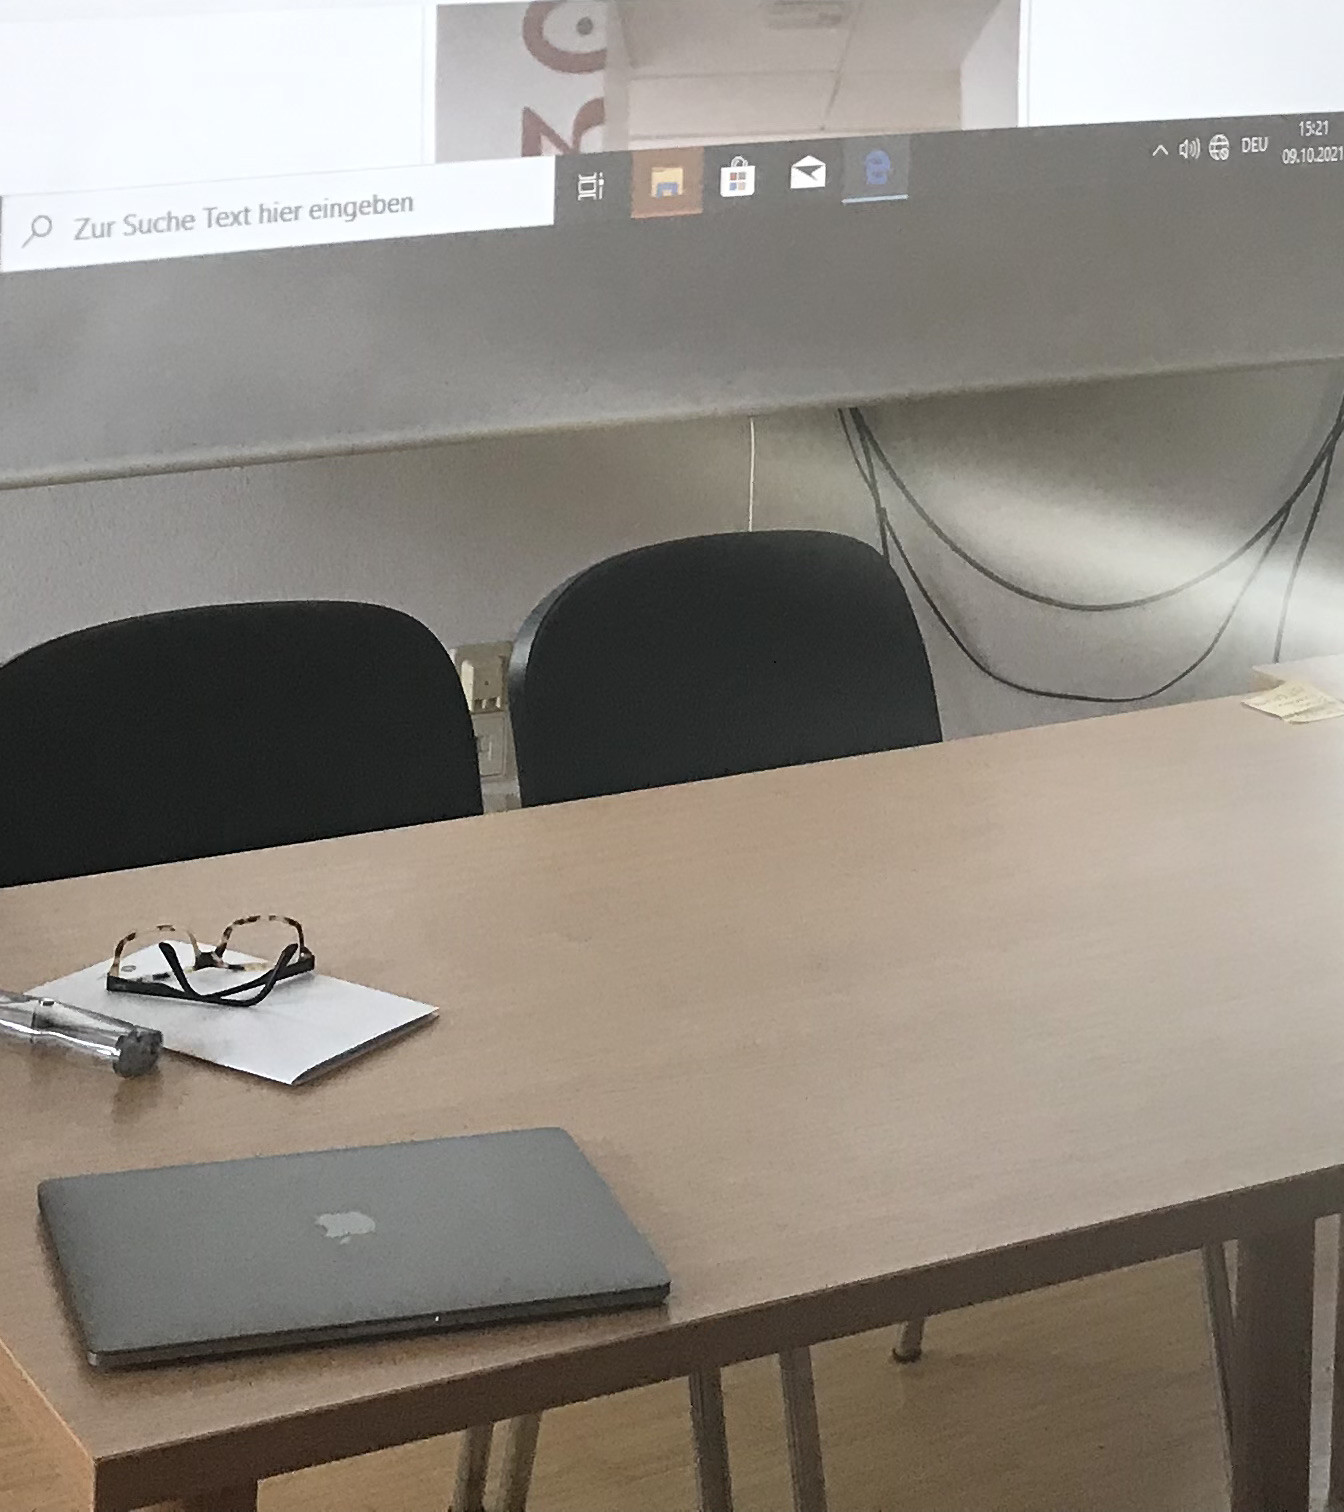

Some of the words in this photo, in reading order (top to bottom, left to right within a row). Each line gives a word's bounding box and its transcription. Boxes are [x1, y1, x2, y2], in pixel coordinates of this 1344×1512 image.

[1298, 120, 1329, 137] 15:21
[1241, 137, 1269, 153] DEU
[1281, 146, 1344, 164] 09.10.2021
[74, 217, 116, 241] Zur
[123, 210, 196, 236] Suche
[203, 206, 252, 228] Text
[259, 201, 303, 225] hier
[309, 194, 413, 223] eingeben
